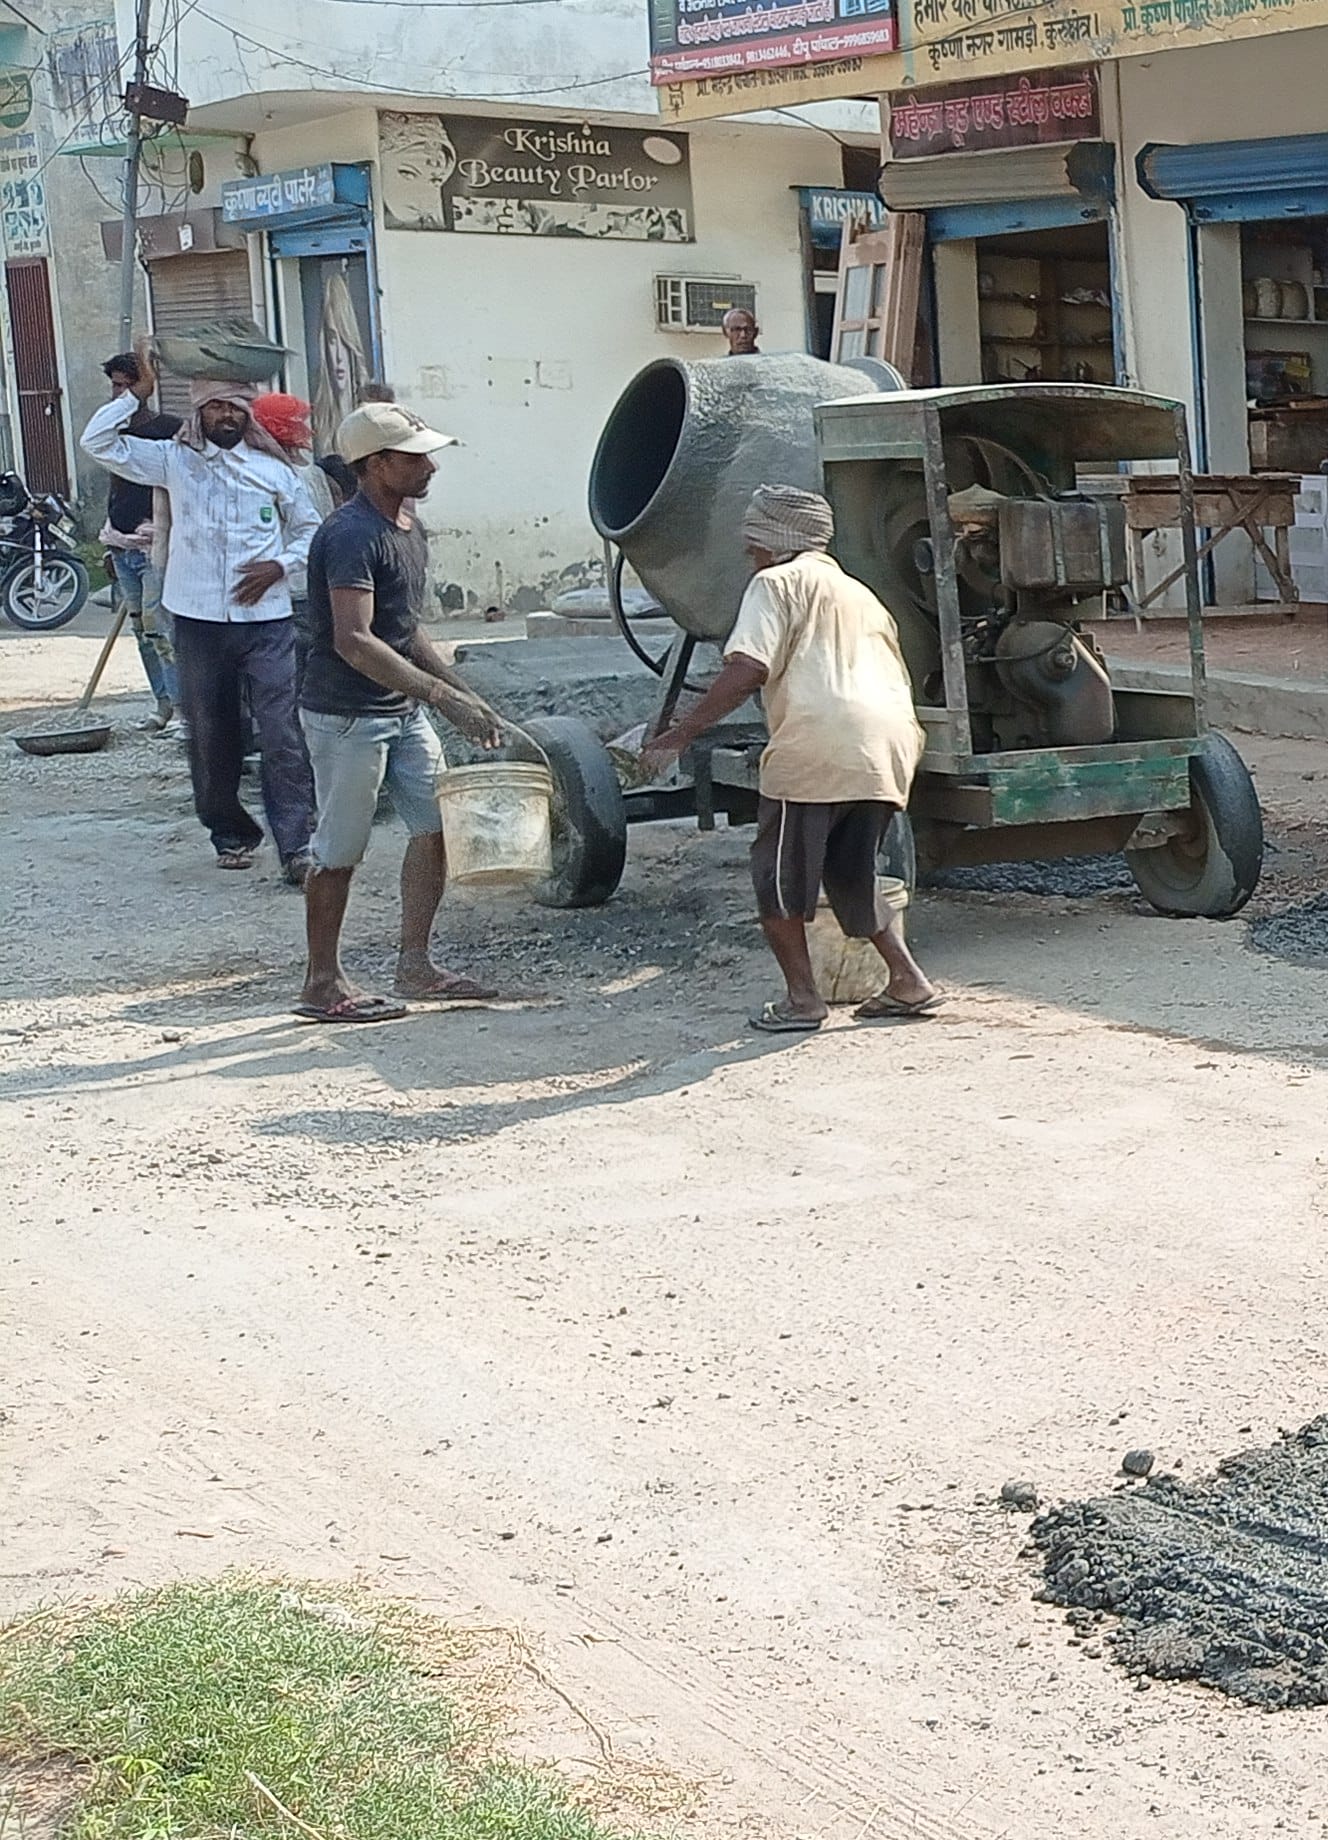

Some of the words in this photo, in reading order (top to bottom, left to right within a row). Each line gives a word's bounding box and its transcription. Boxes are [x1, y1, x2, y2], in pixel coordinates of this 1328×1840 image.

[928, 37, 965, 70] कृष्णा
[966, 32, 994, 56] नगर
[504, 128, 611, 161] Krishna
[458, 159, 562, 194] Beauty
[567, 164, 659, 195] Parlor
[812, 195, 877, 225] KRISHNA
